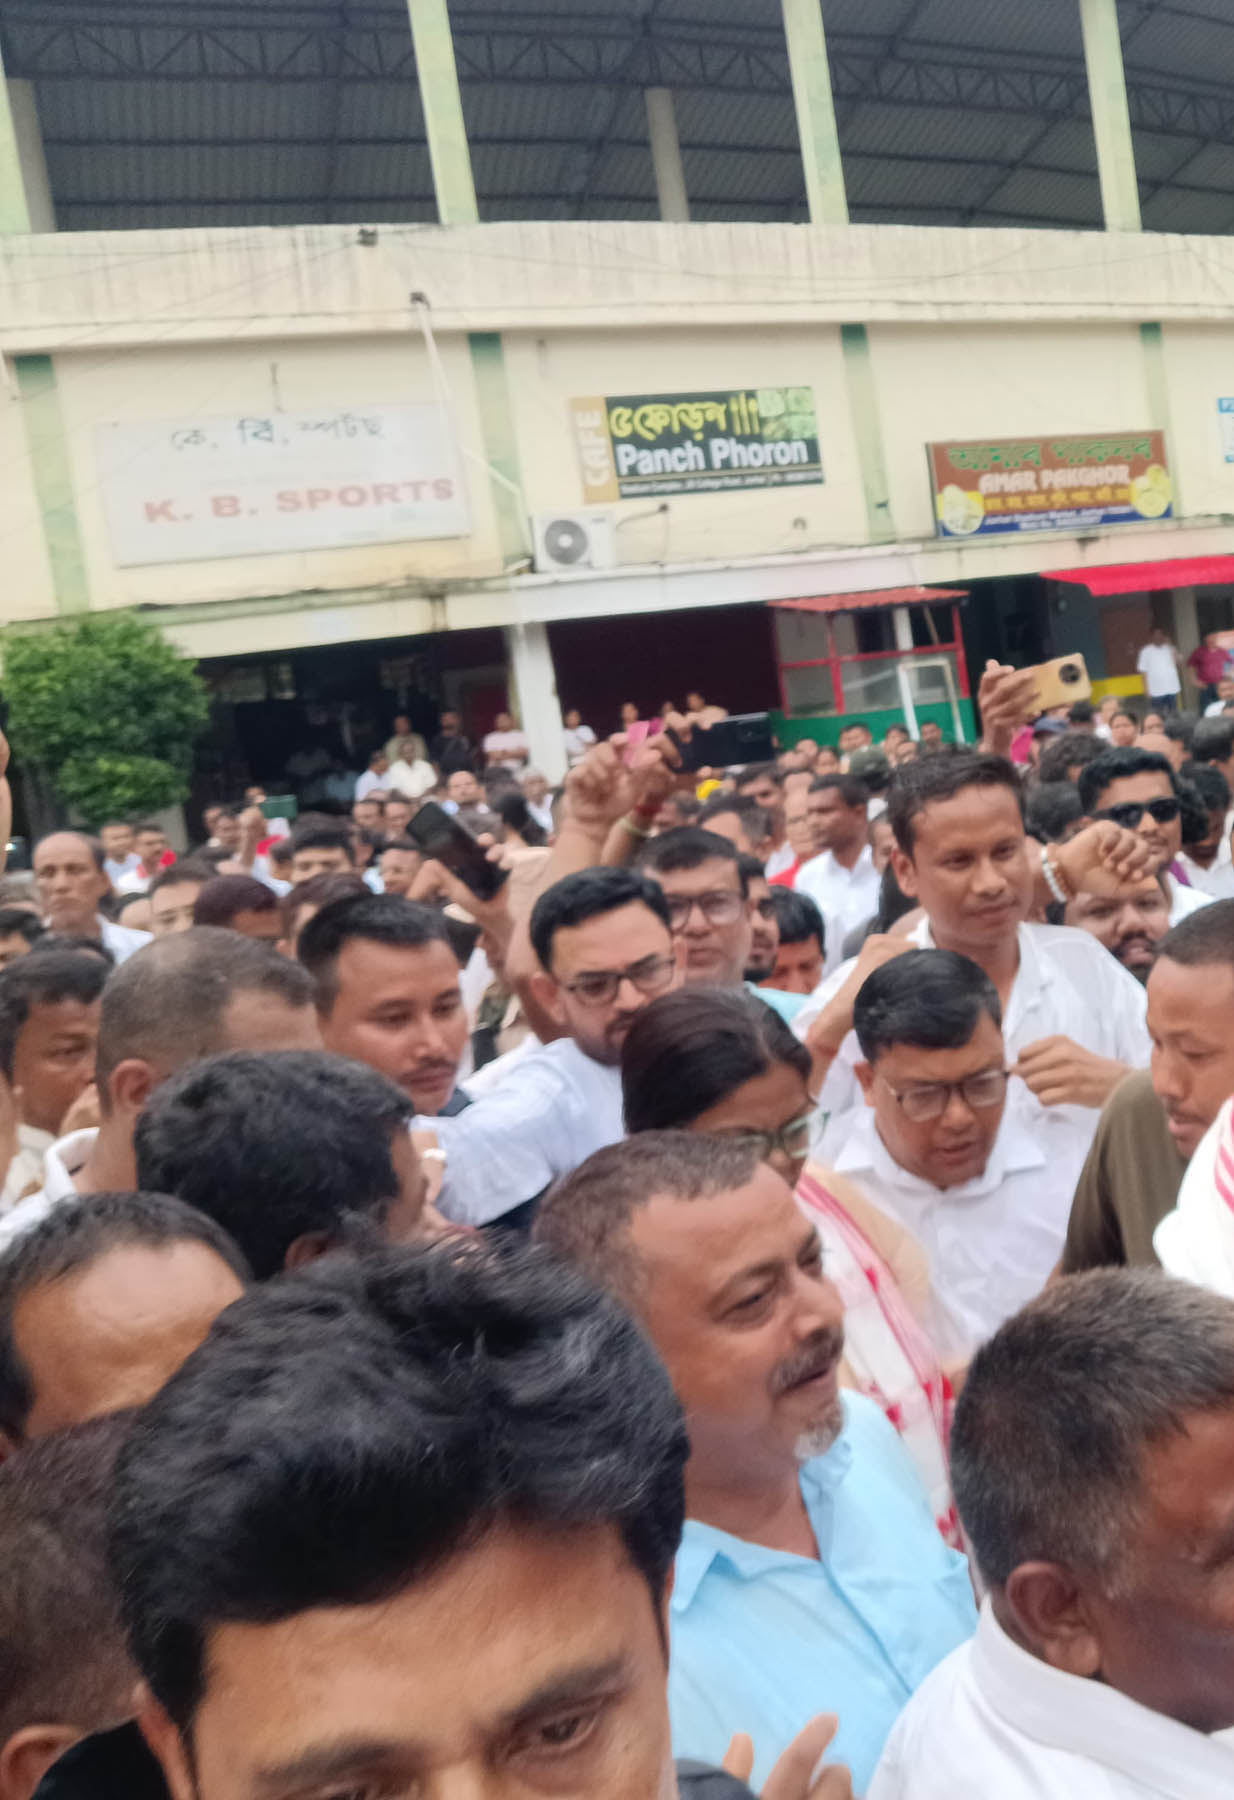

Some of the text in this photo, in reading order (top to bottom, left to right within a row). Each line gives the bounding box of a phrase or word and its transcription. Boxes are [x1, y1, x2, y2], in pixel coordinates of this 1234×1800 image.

[615, 437, 809, 476] Panch Phoron
[276, 478, 455, 513] SPORTS
